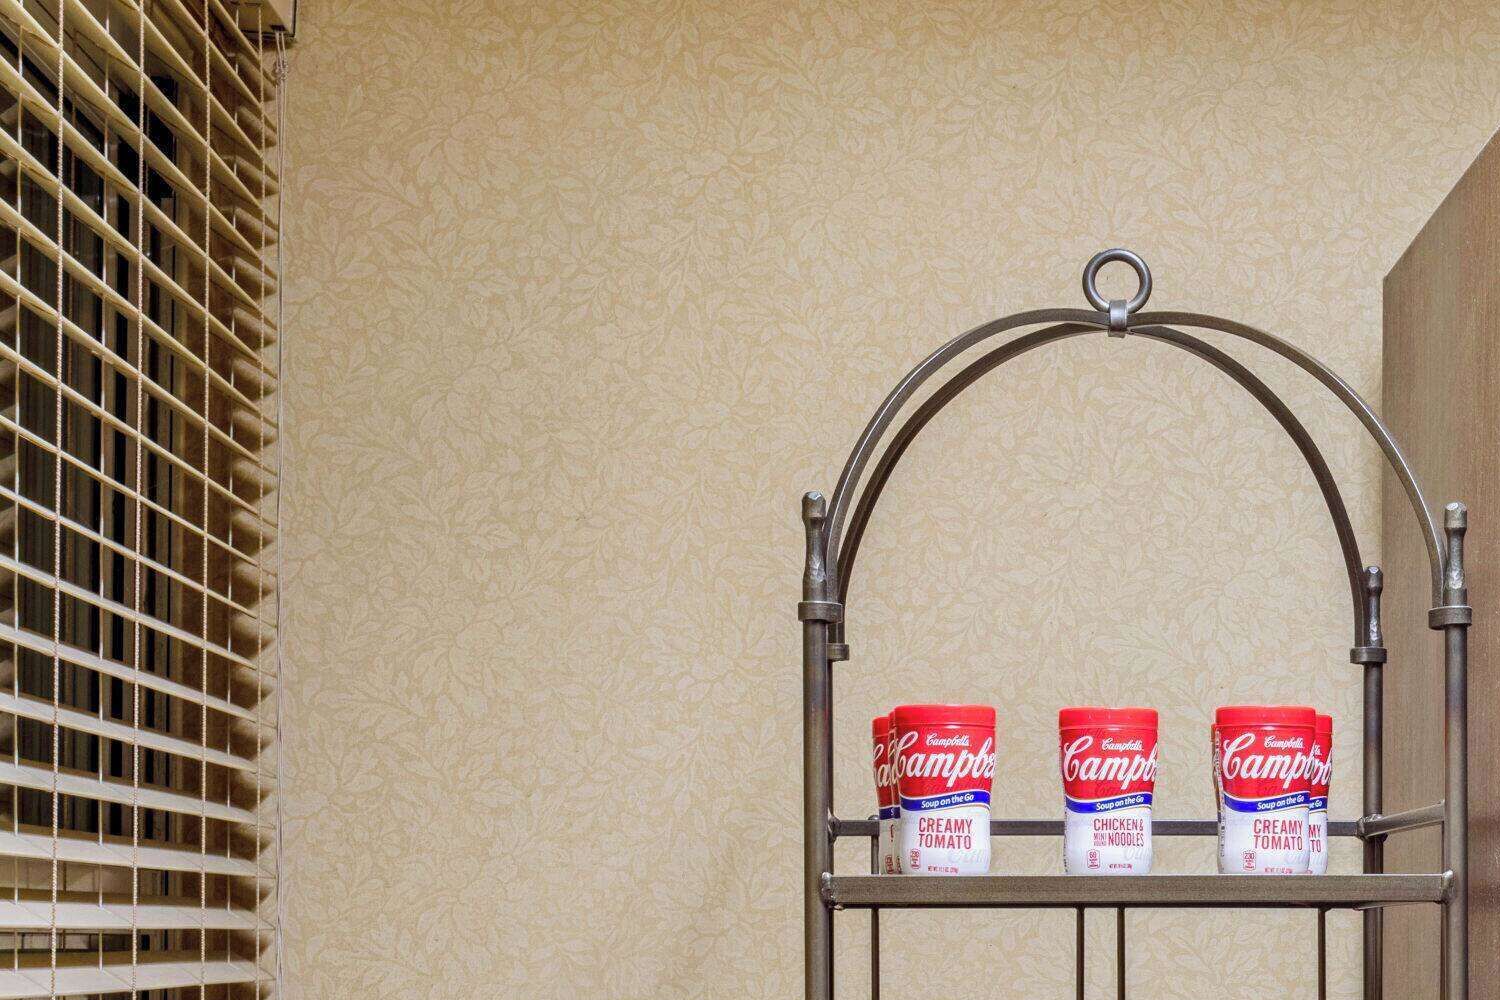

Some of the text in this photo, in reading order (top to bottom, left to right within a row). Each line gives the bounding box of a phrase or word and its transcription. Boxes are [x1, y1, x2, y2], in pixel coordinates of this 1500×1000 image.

[921, 793, 974, 809] Soup on the Go
[1096, 802, 1114, 811] Soup
[1115, 800, 1125, 808] on
[1125, 796, 1136, 806] the
[1257, 801, 1275, 810] Soup
[1276, 799, 1286, 808] on
[1286, 796, 1296, 806] the
[918, 817, 973, 834] CREAMY
[1093, 818, 1138, 832] CHICKEN
[1253, 818, 1303, 835] CREAMY
[918, 833, 972, 850] TOMATO
[1108, 832, 1145, 847] NOODLES
[1253, 835, 1303, 851] TOMATO
